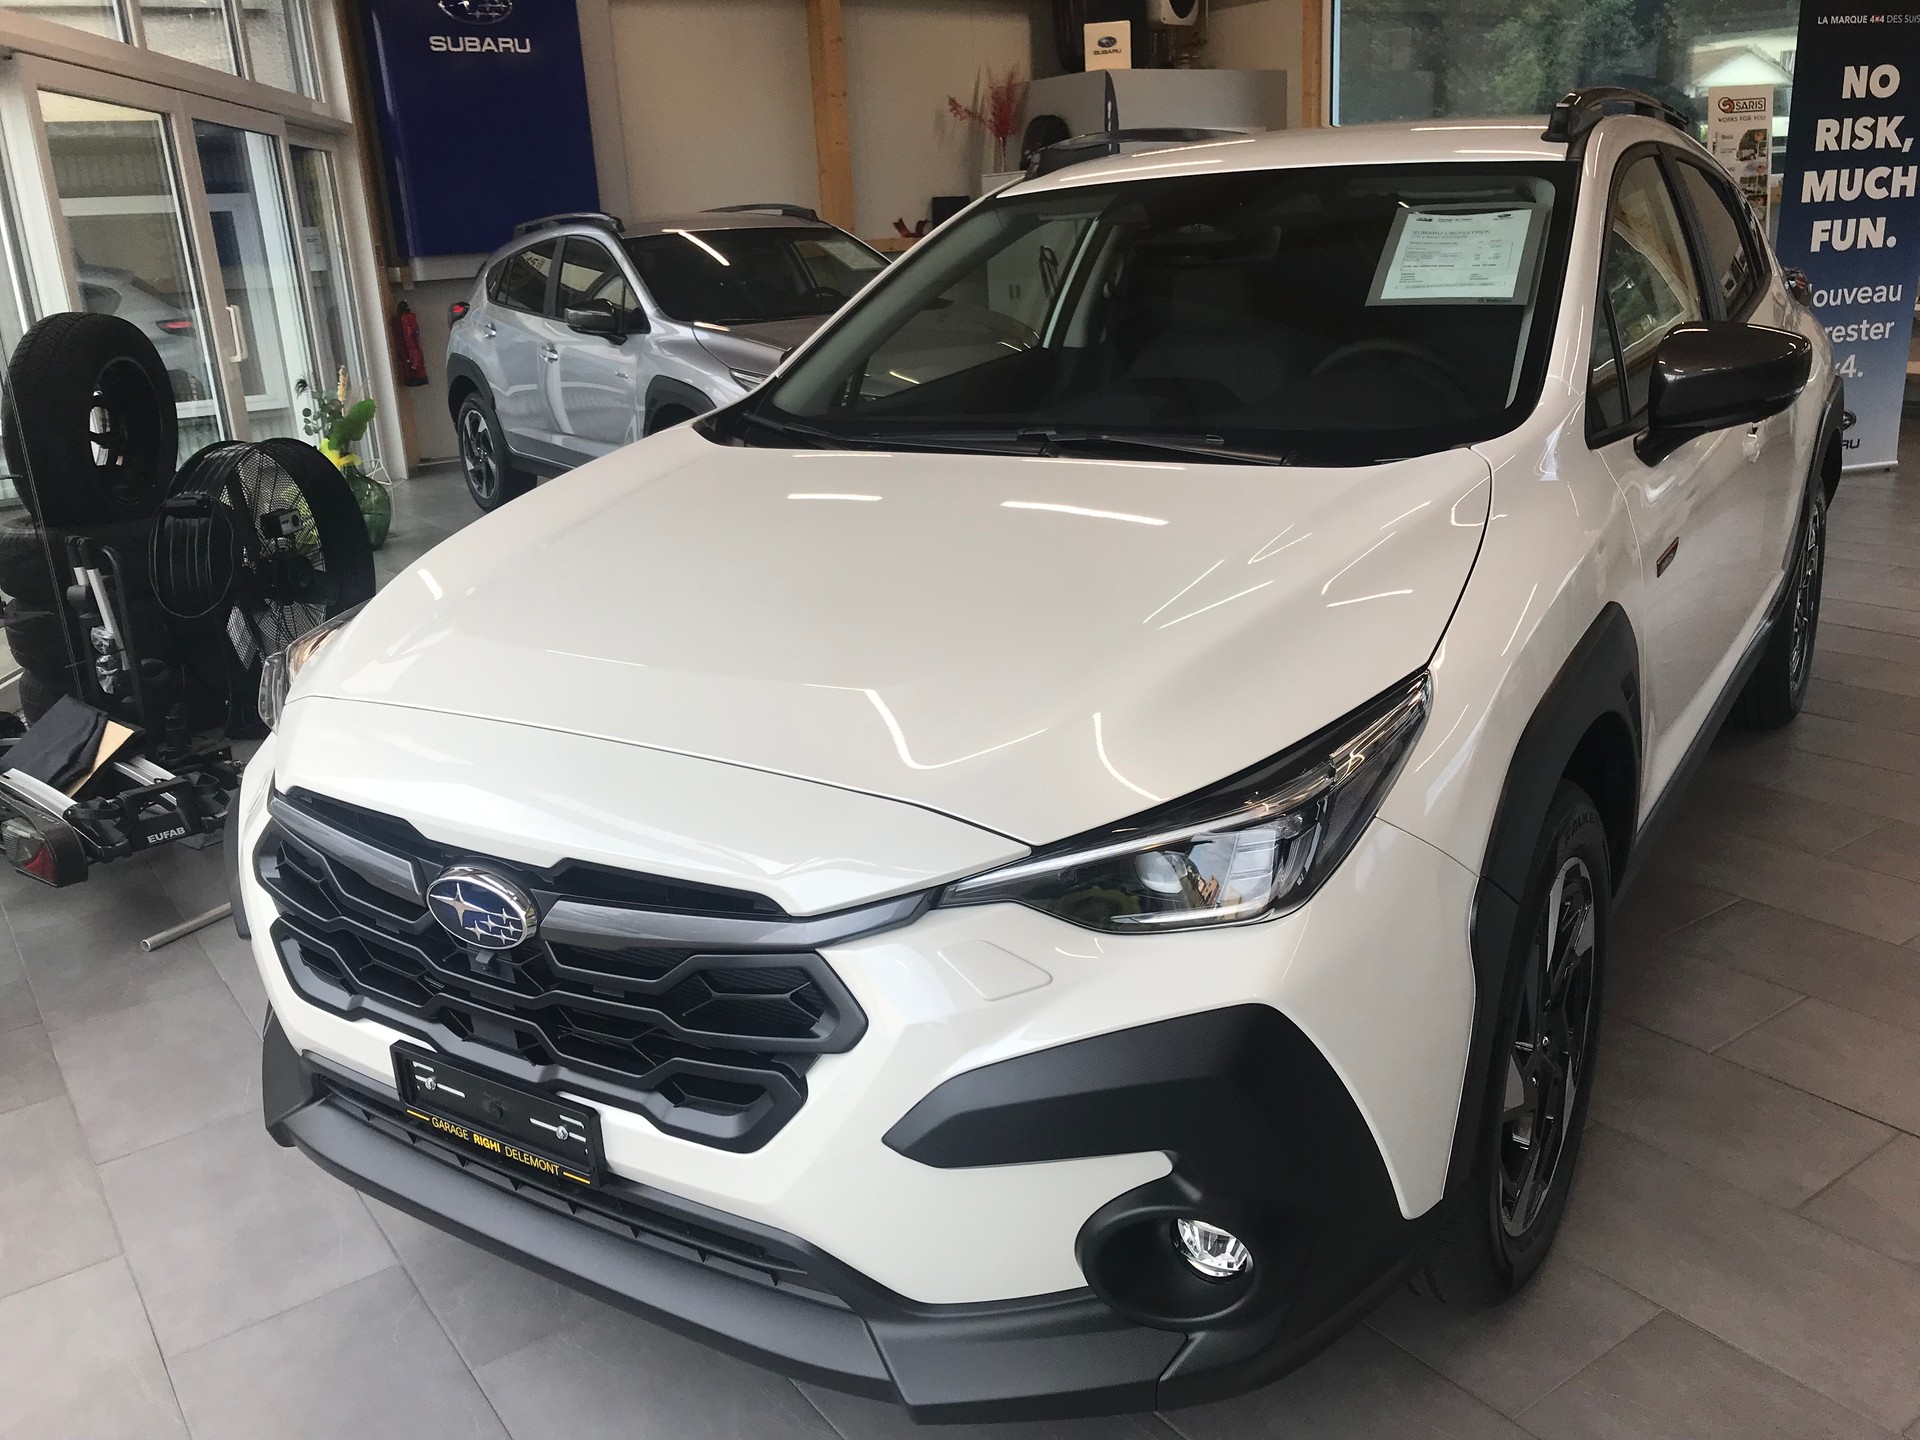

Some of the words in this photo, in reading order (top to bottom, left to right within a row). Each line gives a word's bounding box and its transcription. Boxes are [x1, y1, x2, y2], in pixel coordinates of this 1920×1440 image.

[1817, 15, 1829, 25] LA
[1830, 15, 1868, 25] MARQUE
[1886, 14, 1903, 23] DES
[429, 35, 531, 53] SUBARU
[1093, 48, 1122, 56] SUBARU
[1841, 63, 1901, 100] NO
[1735, 99, 1764, 111] SARIS
[1814, 115, 1914, 153] RISK,
[1801, 164, 1918, 203] MUCH
[1810, 216, 1898, 253] FUN.
[1809, 283, 1903, 309] ouveau
[1824, 319, 1895, 344] rester
[146, 826, 186, 845] EUFAB
[431, 1115, 470, 1141] GARAGE
[472, 1133, 501, 1153] RIGHI
[504, 1145, 560, 1176] DELEMONT
